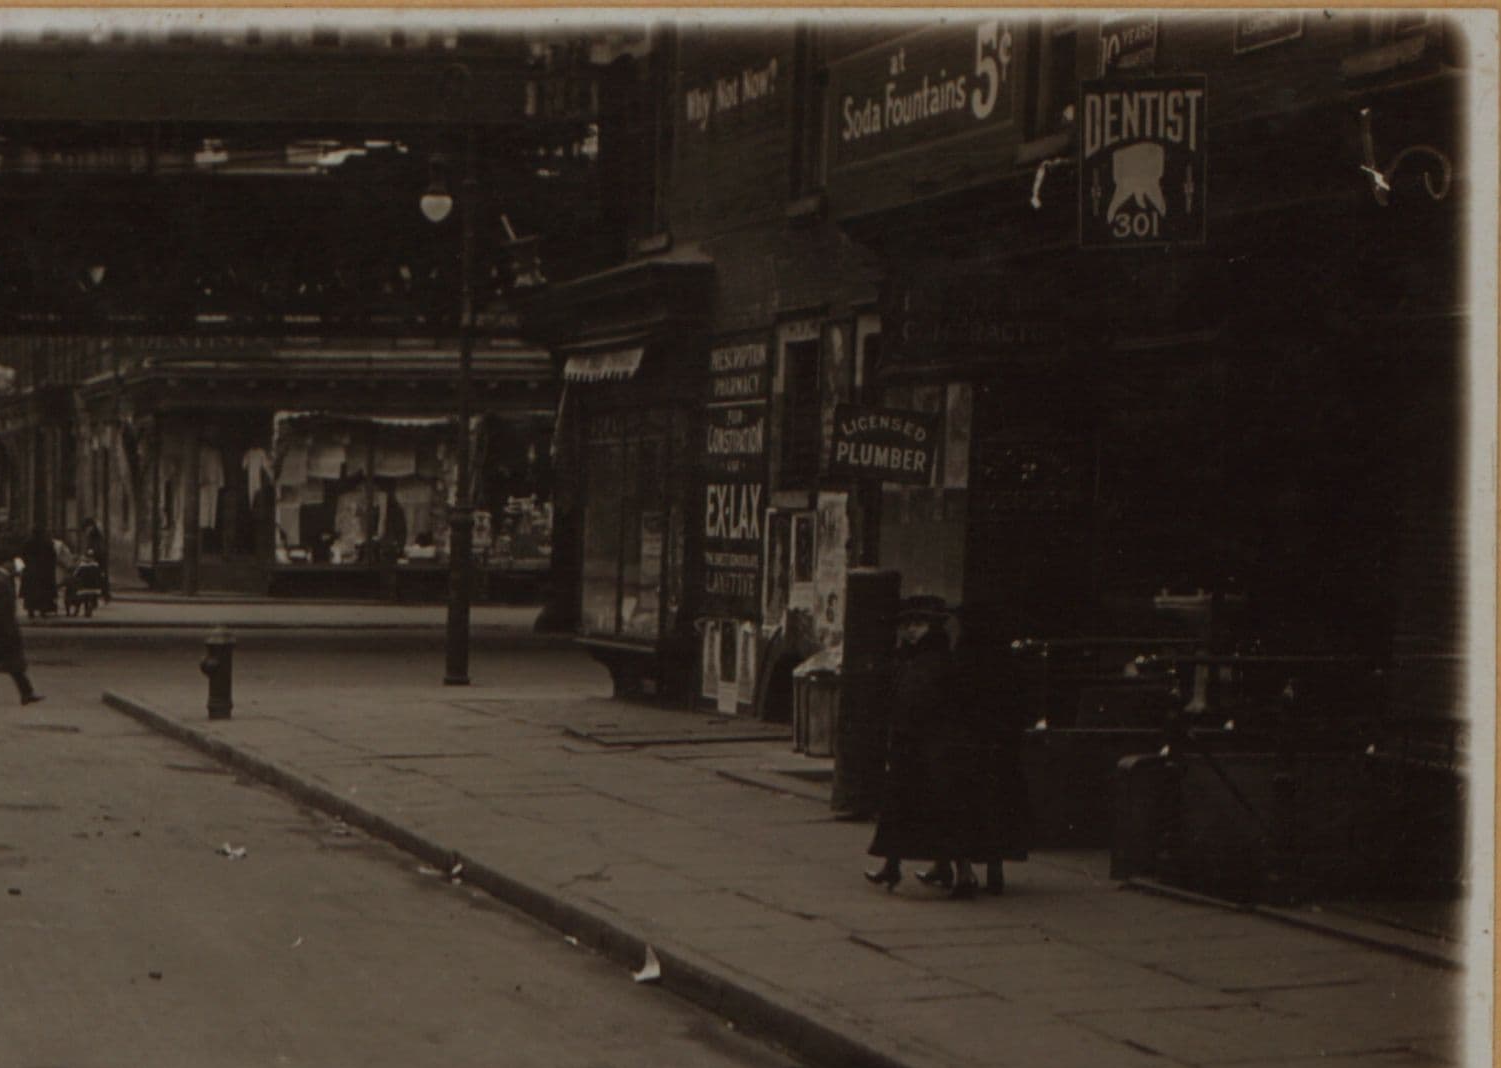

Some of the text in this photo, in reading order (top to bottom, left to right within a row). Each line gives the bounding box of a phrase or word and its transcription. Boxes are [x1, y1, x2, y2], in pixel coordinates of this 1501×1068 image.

[889, 47, 905, 76] at
[686, 57, 779, 131] Why Not Now?
[841, 68, 966, 142] Soda Fountains
[1084, 89, 1204, 159] DENTIST
[1112, 210, 1161, 239] 301
[841, 415, 927, 442] LICENSED
[836, 441, 927, 473] PLUMBER
